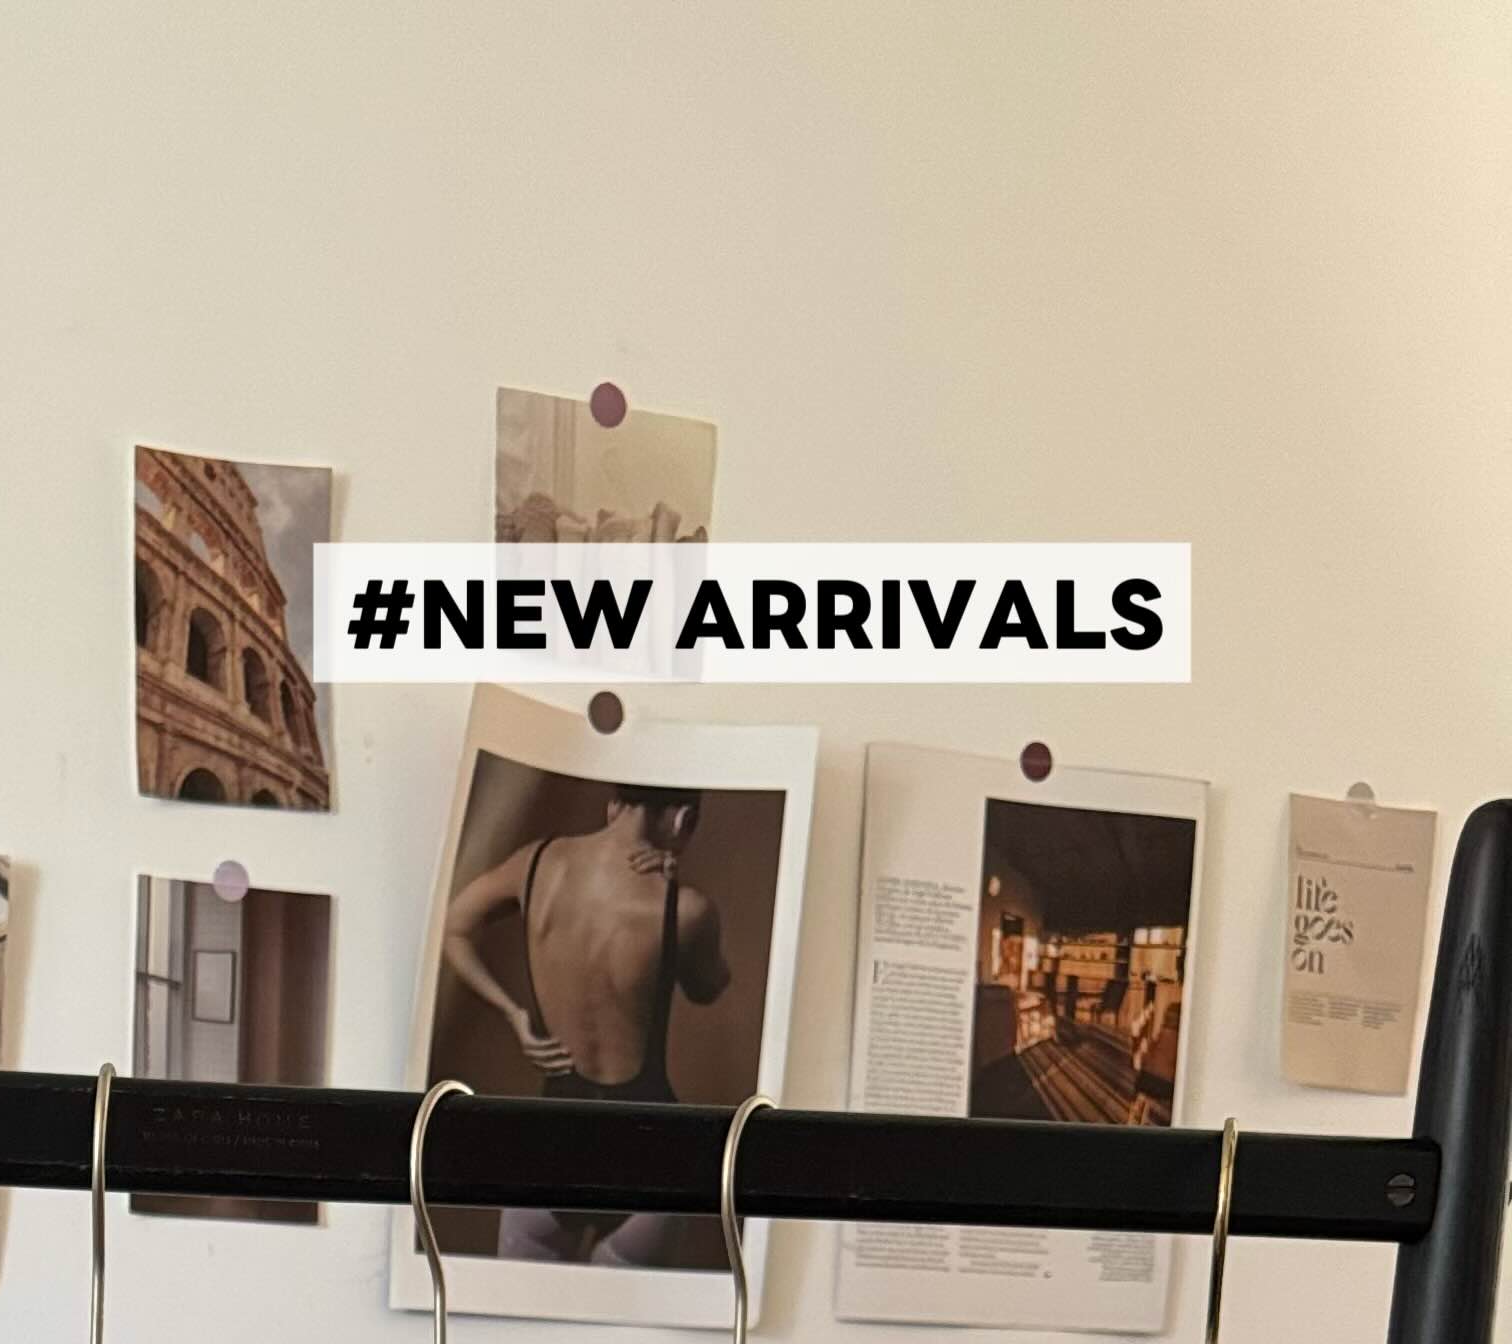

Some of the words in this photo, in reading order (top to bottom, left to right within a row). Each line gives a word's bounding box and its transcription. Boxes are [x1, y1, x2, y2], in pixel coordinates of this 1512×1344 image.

[1296, 875, 1338, 914] life
[1294, 915, 1354, 946] goes
[1291, 948, 1324, 974] on
